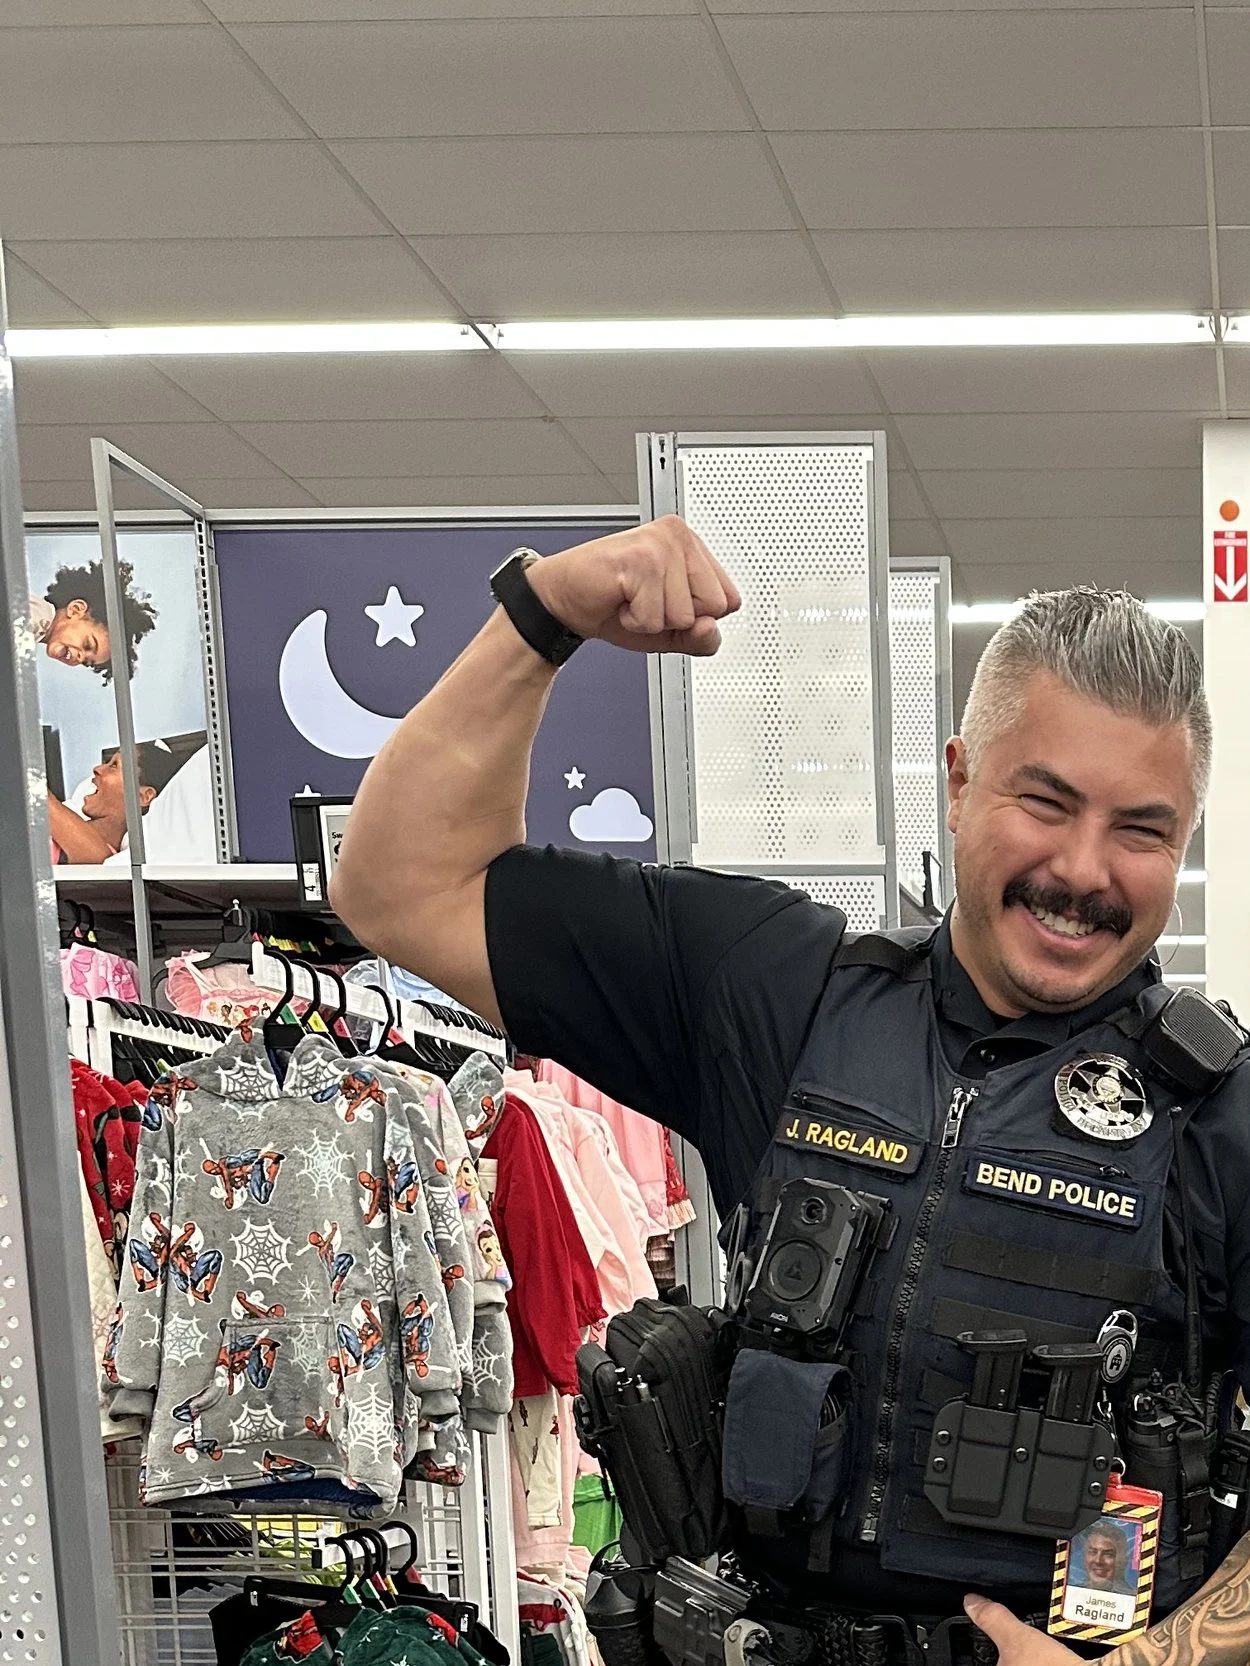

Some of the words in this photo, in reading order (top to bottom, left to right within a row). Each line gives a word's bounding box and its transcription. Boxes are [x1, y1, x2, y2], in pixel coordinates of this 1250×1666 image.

[786, 1118, 800, 1139] J.
[804, 1122, 908, 1164] RAGLAND
[976, 1162, 1042, 1195] BEND
[1048, 1178, 1137, 1218] POLICE
[1075, 1604, 1125, 1622] Ragland
[1085, 1595, 1117, 1609] James
